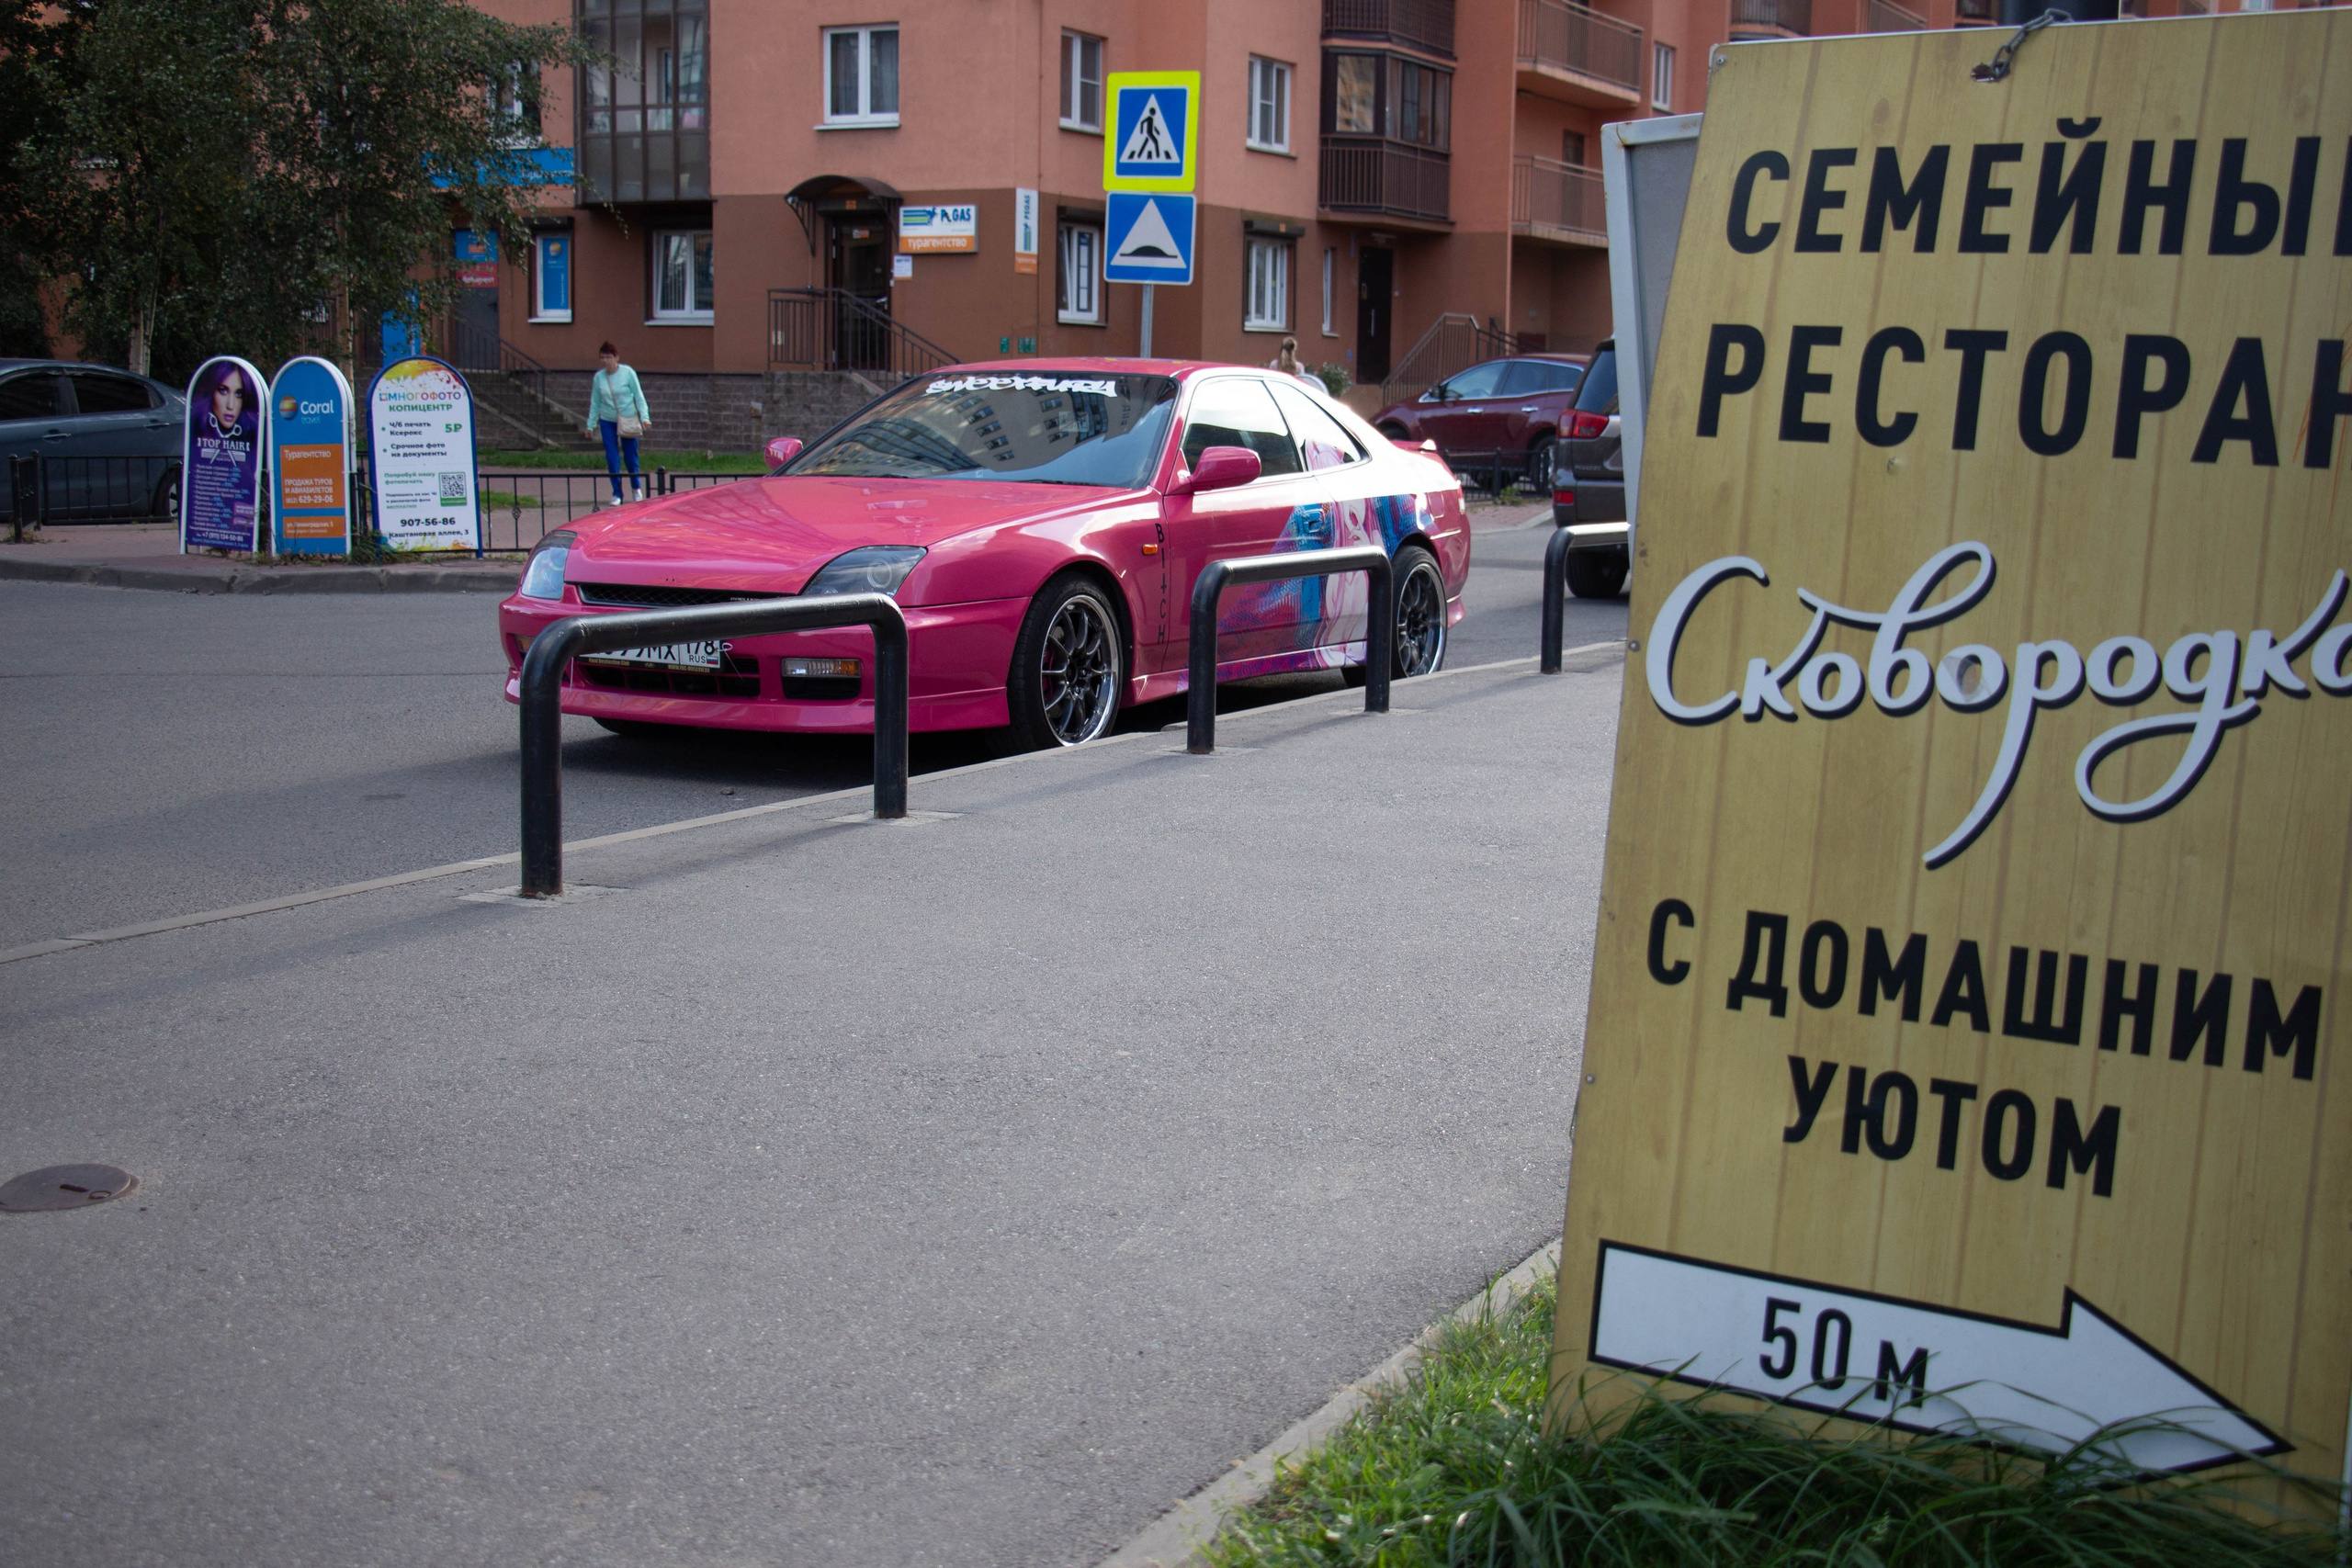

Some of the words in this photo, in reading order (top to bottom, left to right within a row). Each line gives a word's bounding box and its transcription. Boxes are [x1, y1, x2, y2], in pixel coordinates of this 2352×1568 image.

[1725, 116, 2352, 257] СЕМЕЙНЫ
[908, 237, 967, 249] турагентство
[300, 399, 334, 415] Coral
[389, 404, 453, 412] КОПИЦЕНТР
[203, 438, 220, 448] TOP
[222, 440, 245, 451] HAIR
[284, 449, 332, 459] Турагентство
[285, 479, 313, 487] ПРОДАЖА
[299, 495, 334, 503] 629-29-06
[401, 517, 456, 527] 907-56-86
[689, 655, 706, 663] RUS
[1725, 909, 2323, 1082] ДОМАШНИМ
[1782, 1055, 2121, 1199] УЮТОМ
[1758, 1297, 1852, 1391] 50
